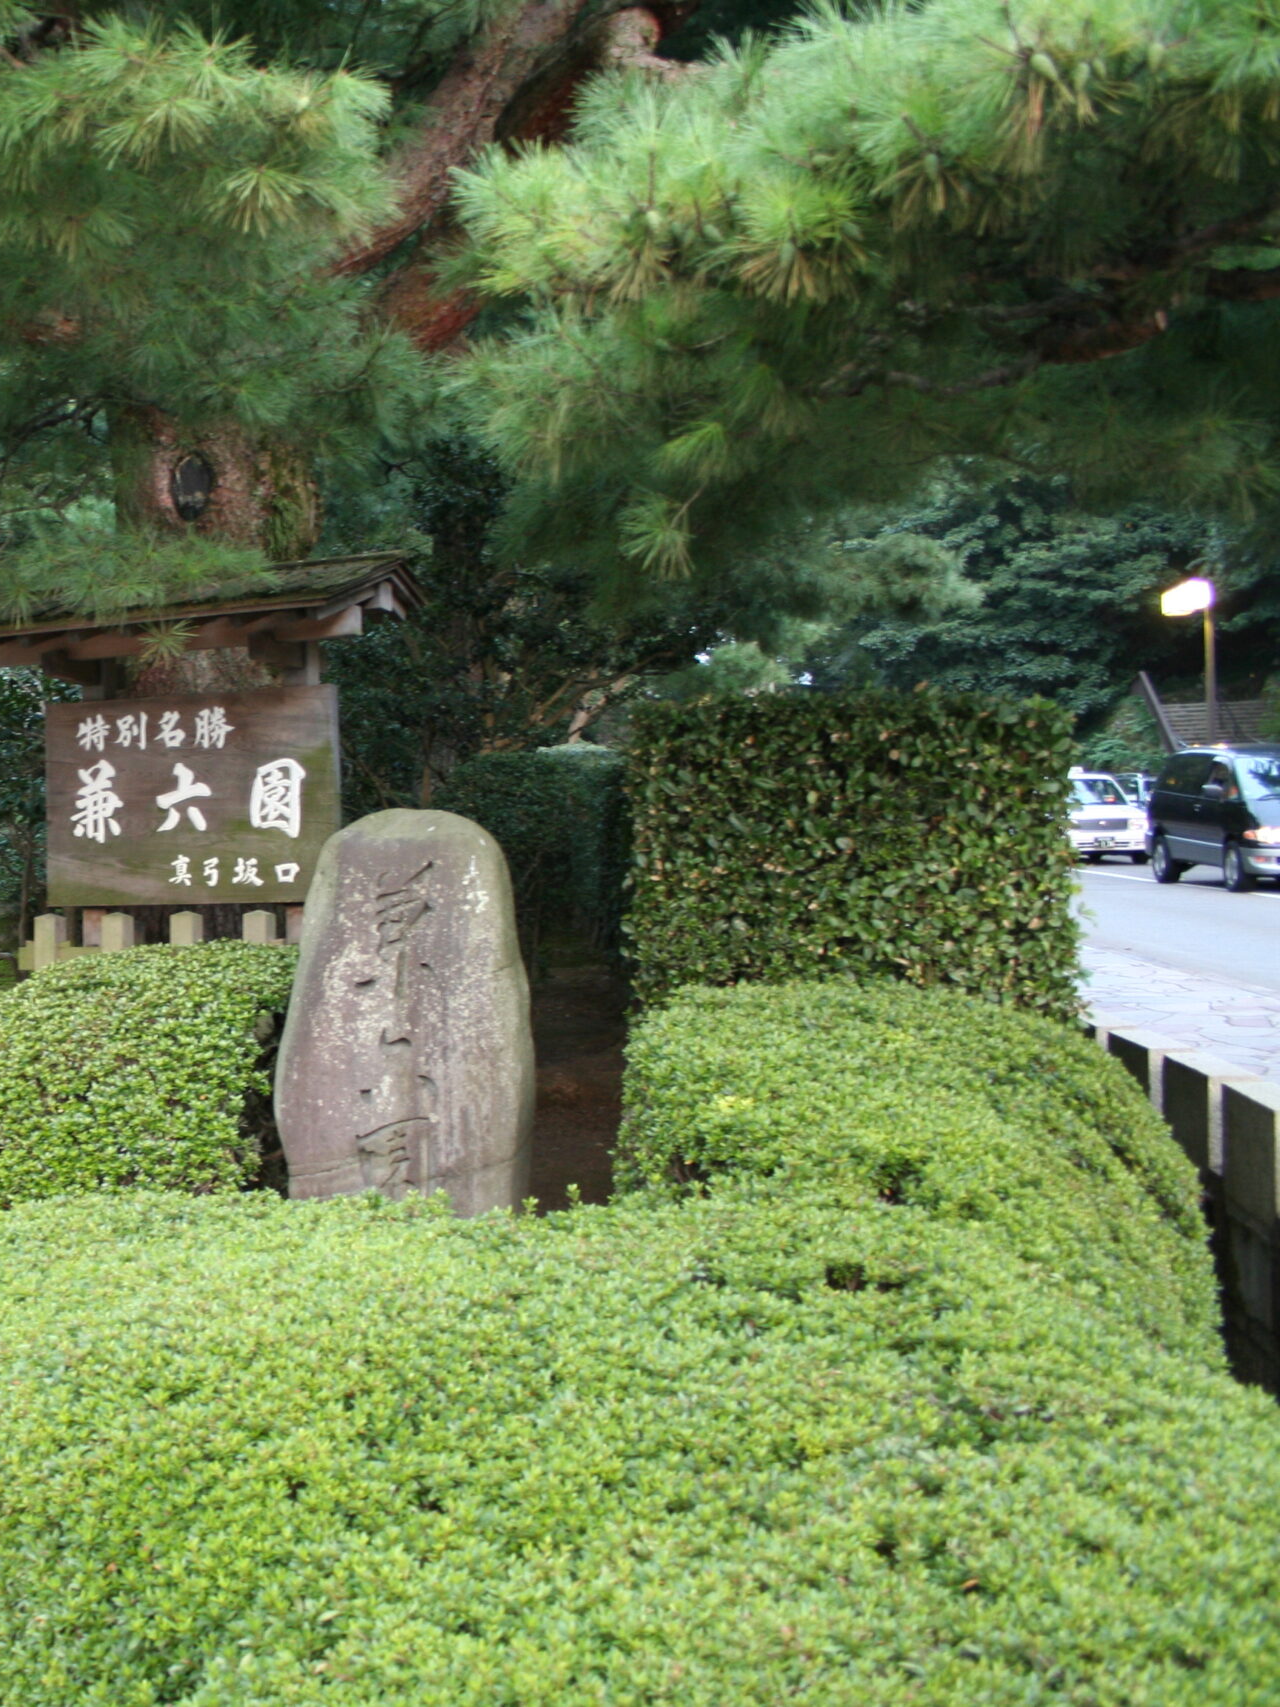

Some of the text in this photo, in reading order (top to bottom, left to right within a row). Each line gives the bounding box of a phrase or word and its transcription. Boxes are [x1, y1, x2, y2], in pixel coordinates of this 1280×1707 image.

[76, 706, 235, 751] 特別名勝
[70, 758, 306, 843] 兼六園
[168, 854, 301, 887] 真弓坂口
